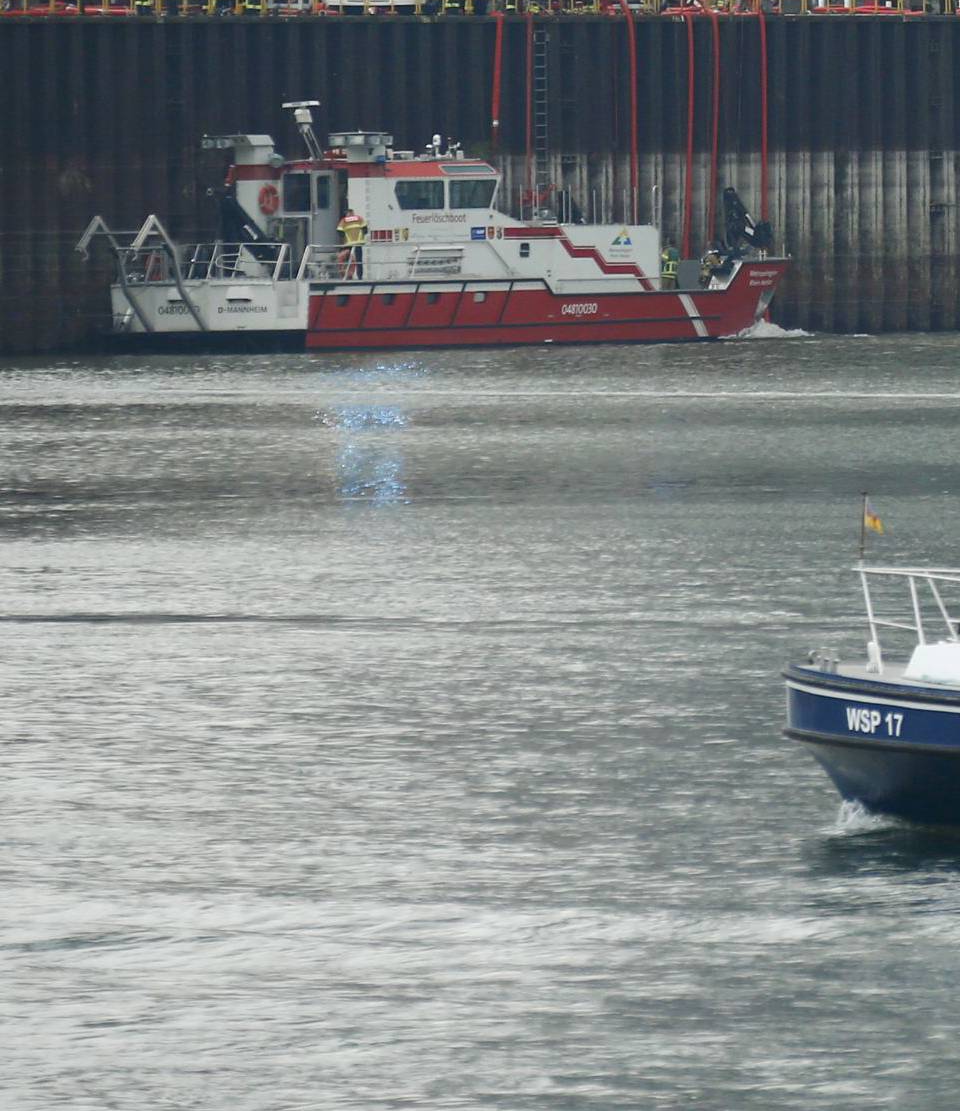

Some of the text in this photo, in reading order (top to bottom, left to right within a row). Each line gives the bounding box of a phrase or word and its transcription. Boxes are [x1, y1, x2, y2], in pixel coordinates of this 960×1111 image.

[412, 213, 467, 224] Feuerlöschboot
[217, 305, 268, 314] D-MANNHEIM
[561, 302, 598, 315] 04810030
[845, 707, 904, 737] WSP 17
